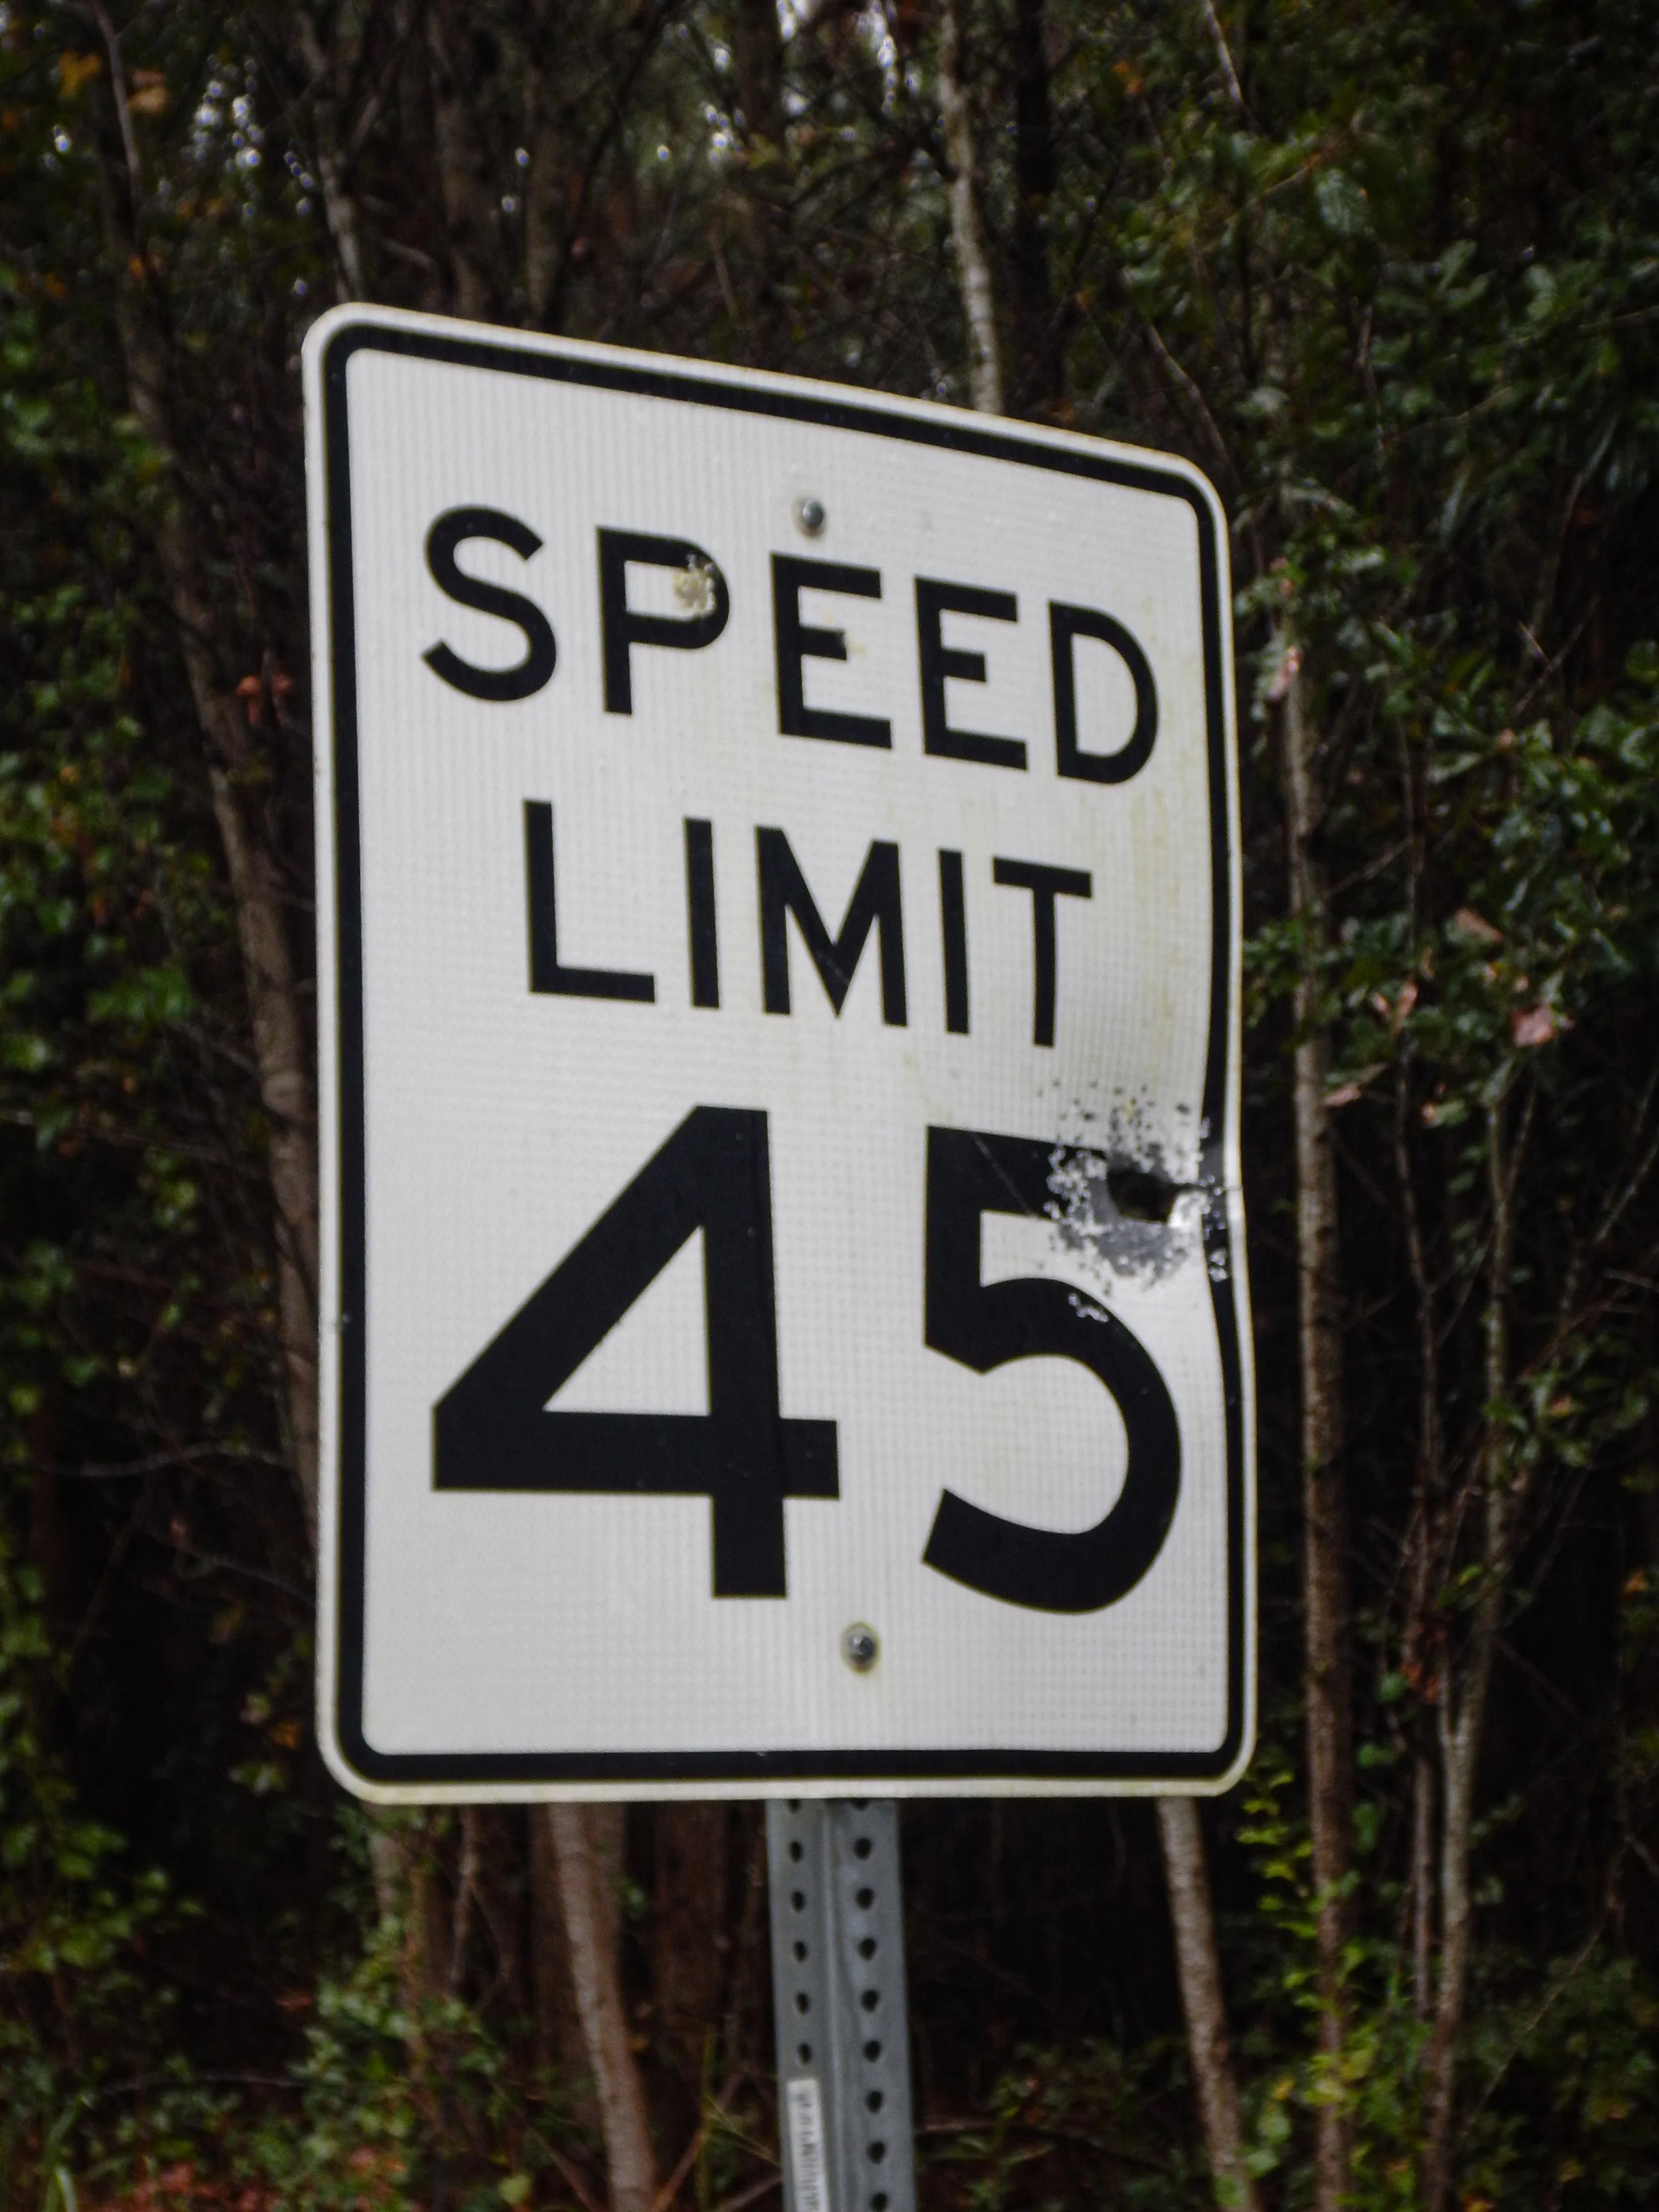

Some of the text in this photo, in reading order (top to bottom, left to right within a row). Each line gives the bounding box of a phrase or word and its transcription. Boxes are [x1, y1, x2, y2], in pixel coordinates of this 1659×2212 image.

[422, 505, 1159, 786] SPEED
[523, 799, 1093, 1049] LIMIT
[431, 1105, 1183, 1615] 45
